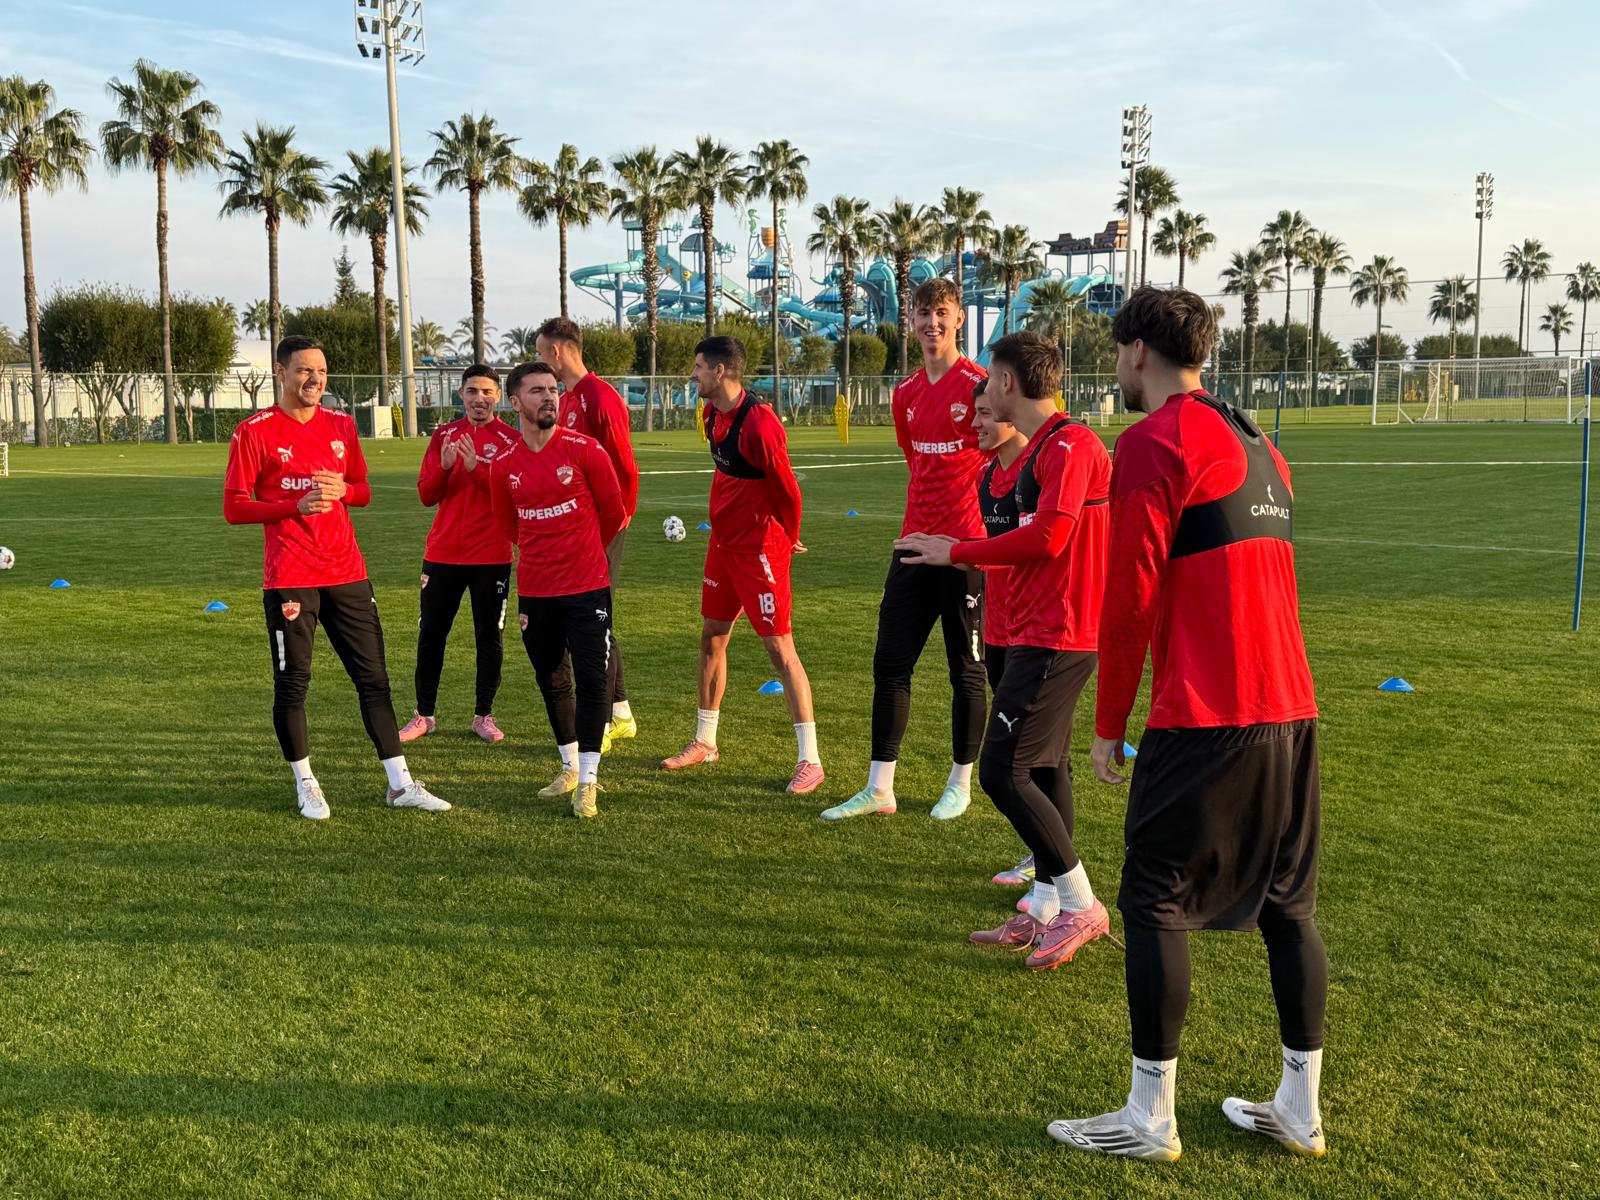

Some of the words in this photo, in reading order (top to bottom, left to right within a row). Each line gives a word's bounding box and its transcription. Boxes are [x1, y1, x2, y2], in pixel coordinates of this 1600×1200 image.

[280, 477, 321, 490] SUPE
[1251, 504, 1290, 520] CATAPULT
[758, 592, 776, 614] 18
